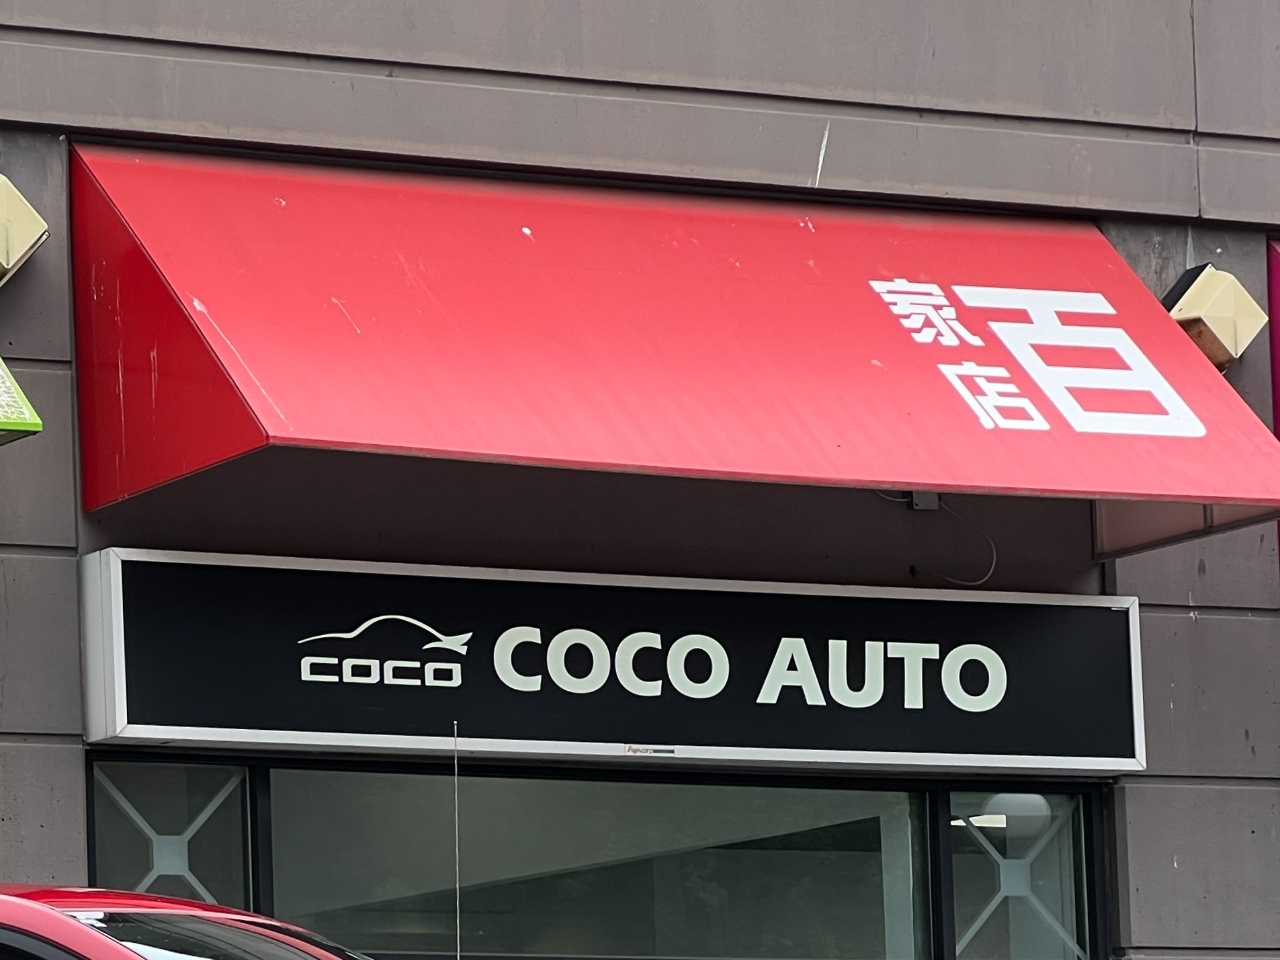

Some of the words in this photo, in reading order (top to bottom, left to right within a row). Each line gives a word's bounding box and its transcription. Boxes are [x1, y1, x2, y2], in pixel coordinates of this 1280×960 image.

[300, 655, 463, 688] COCO
[492, 626, 730, 699] COCO
[755, 637, 1008, 713] AUTO
